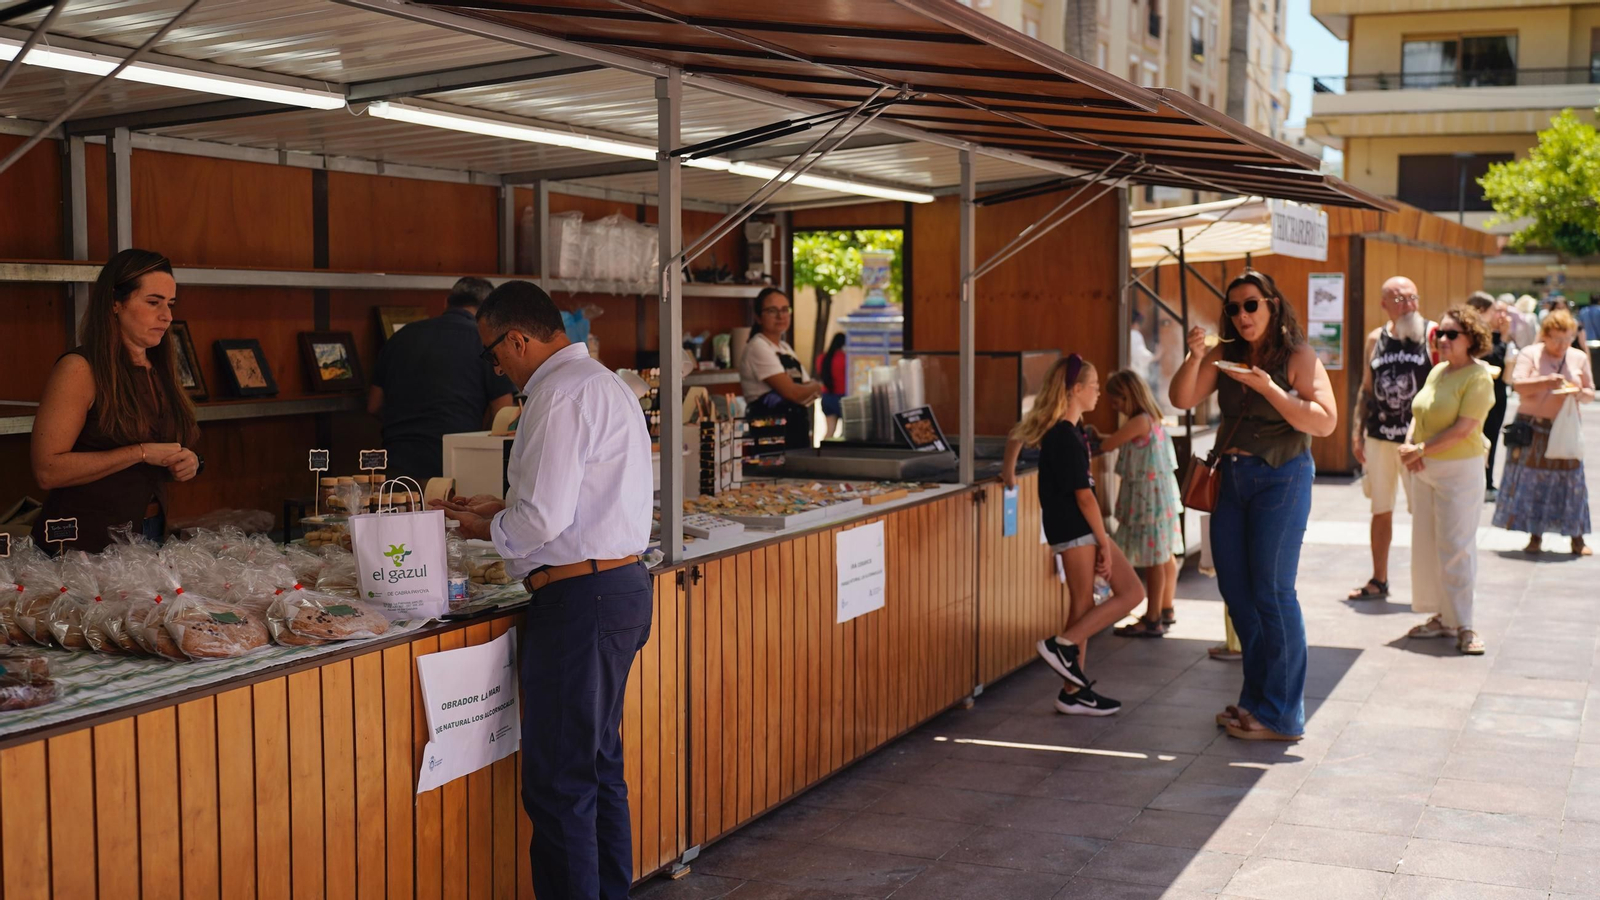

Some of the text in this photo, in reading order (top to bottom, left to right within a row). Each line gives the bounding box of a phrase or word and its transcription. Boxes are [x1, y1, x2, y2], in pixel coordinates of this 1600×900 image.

[372, 564, 427, 583] el gazul
[441, 695, 479, 711] OBRADOR
[488, 685, 501, 697] MARI
[443, 718, 471, 732] NATURAL
[471, 713, 484, 723] LOS
[485, 697, 515, 718] ALCORNOCALES
